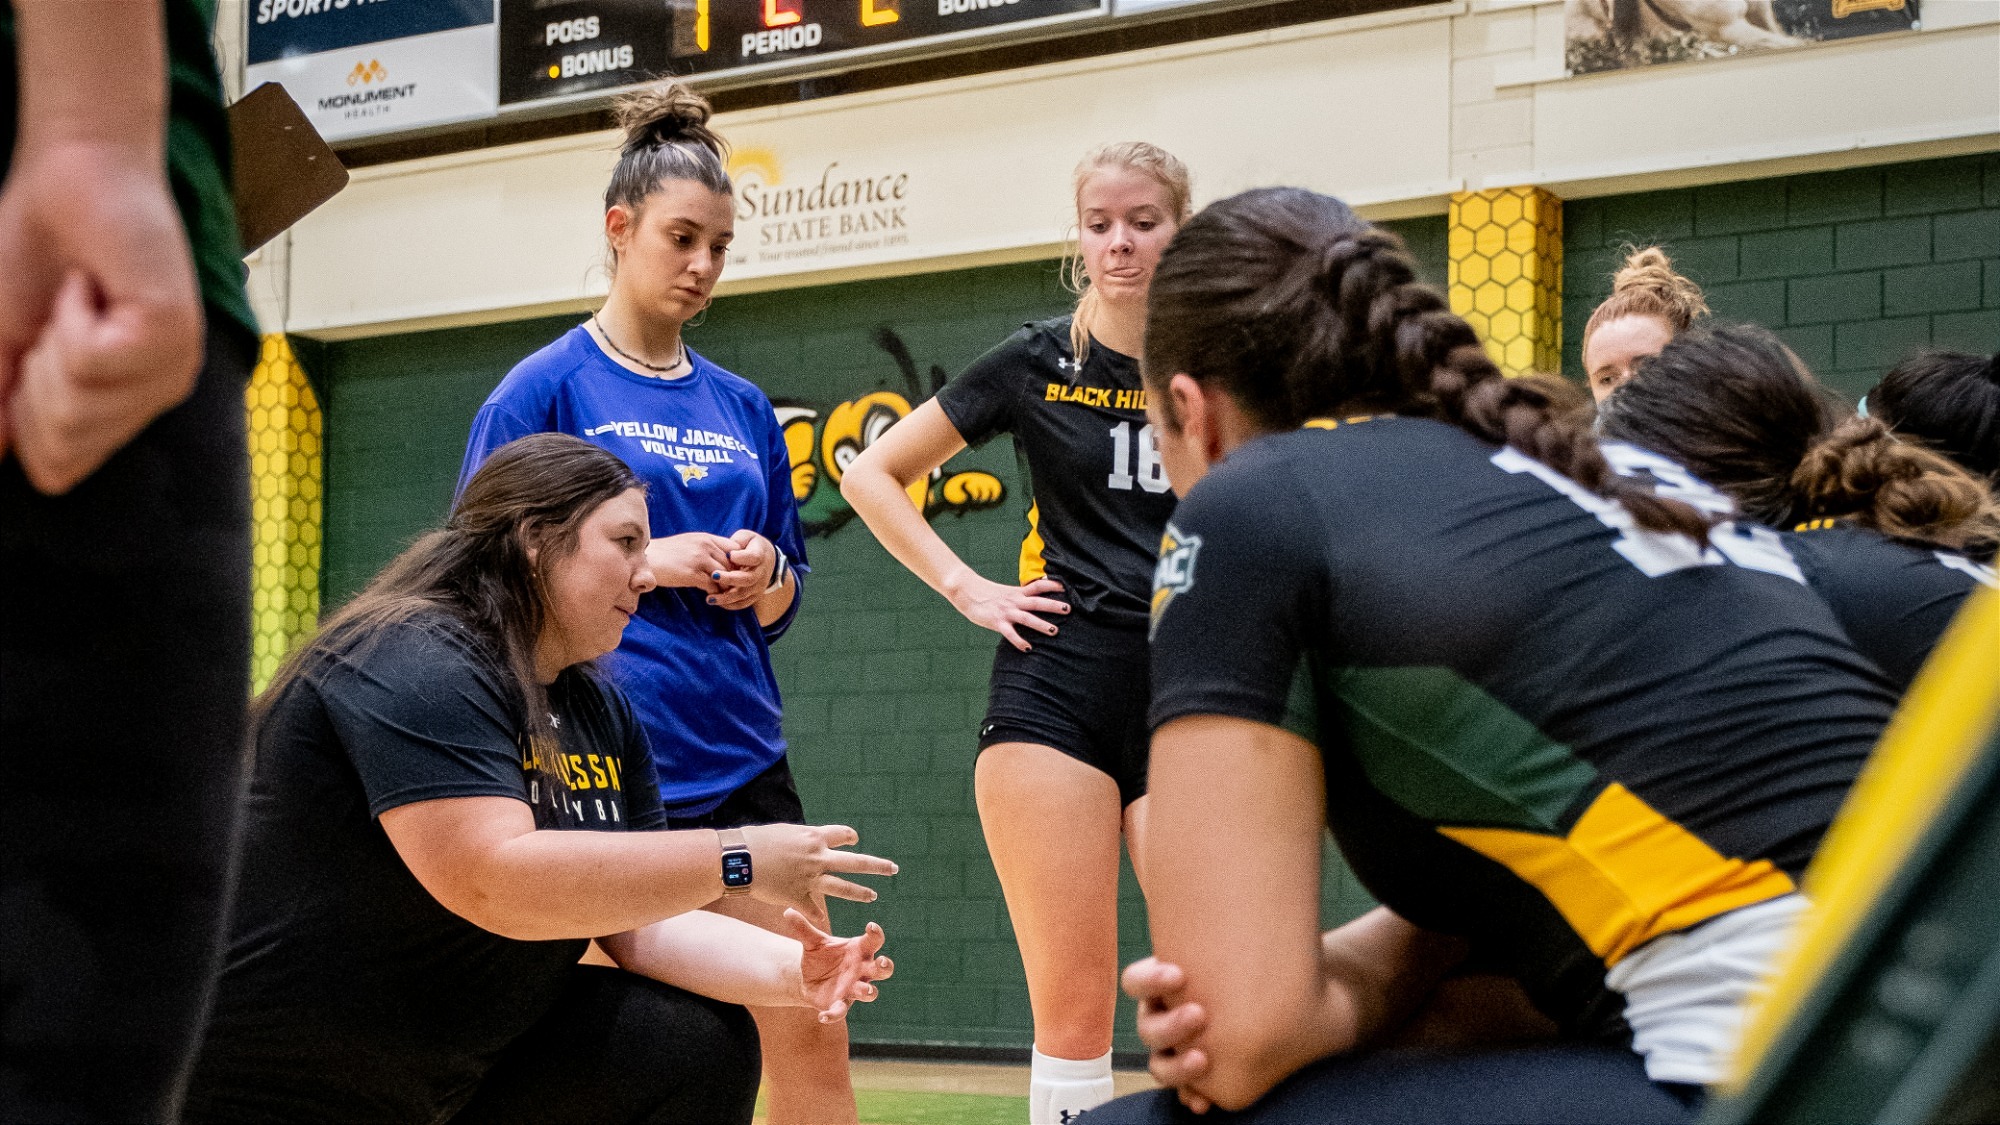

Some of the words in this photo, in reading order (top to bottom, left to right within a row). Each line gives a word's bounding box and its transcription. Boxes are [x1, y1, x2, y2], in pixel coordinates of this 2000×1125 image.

[546, 15, 600, 46] POSS
[741, 23, 822, 57] PERIOD
[561, 44, 634, 78] BONUS
[318, 83, 416, 111] MONUMENT
[344, 105, 390, 120] HEALTH
[737, 161, 909, 221] Sundance
[760, 215, 831, 246] STATE
[839, 205, 908, 236] BANK
[1045, 383, 1112, 408] BLACK
[1115, 389, 1151, 411] HIL
[611, 421, 678, 443] YELLOW
[640, 439, 734, 464] VOLLEYBALL
